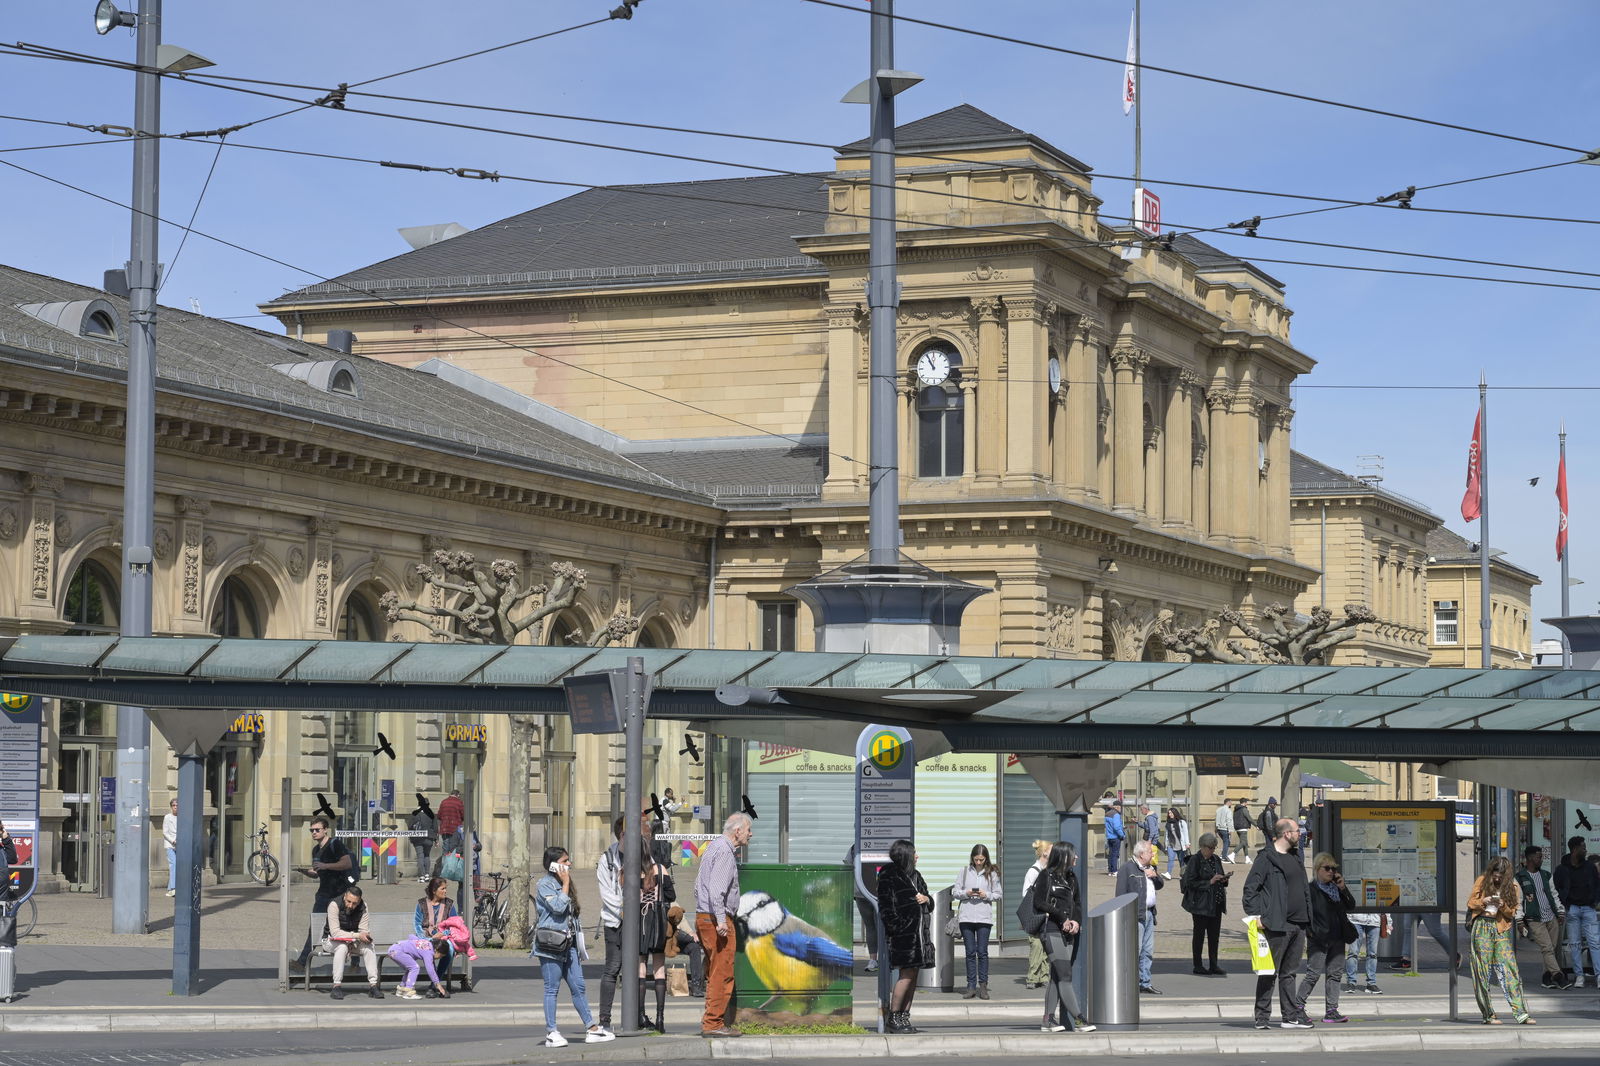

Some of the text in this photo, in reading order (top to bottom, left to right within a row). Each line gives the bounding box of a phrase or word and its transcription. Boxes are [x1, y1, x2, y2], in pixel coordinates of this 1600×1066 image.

[1144, 197, 1158, 232] DB
[446, 724, 487, 742] YORMA'S
[878, 740, 895, 762] H
[795, 763, 852, 771] coffee & snacks
[863, 765, 872, 777] G
[925, 764, 987, 772] coffee & snacks
[864, 828, 872, 836] 76
[864, 841, 872, 849] 92
